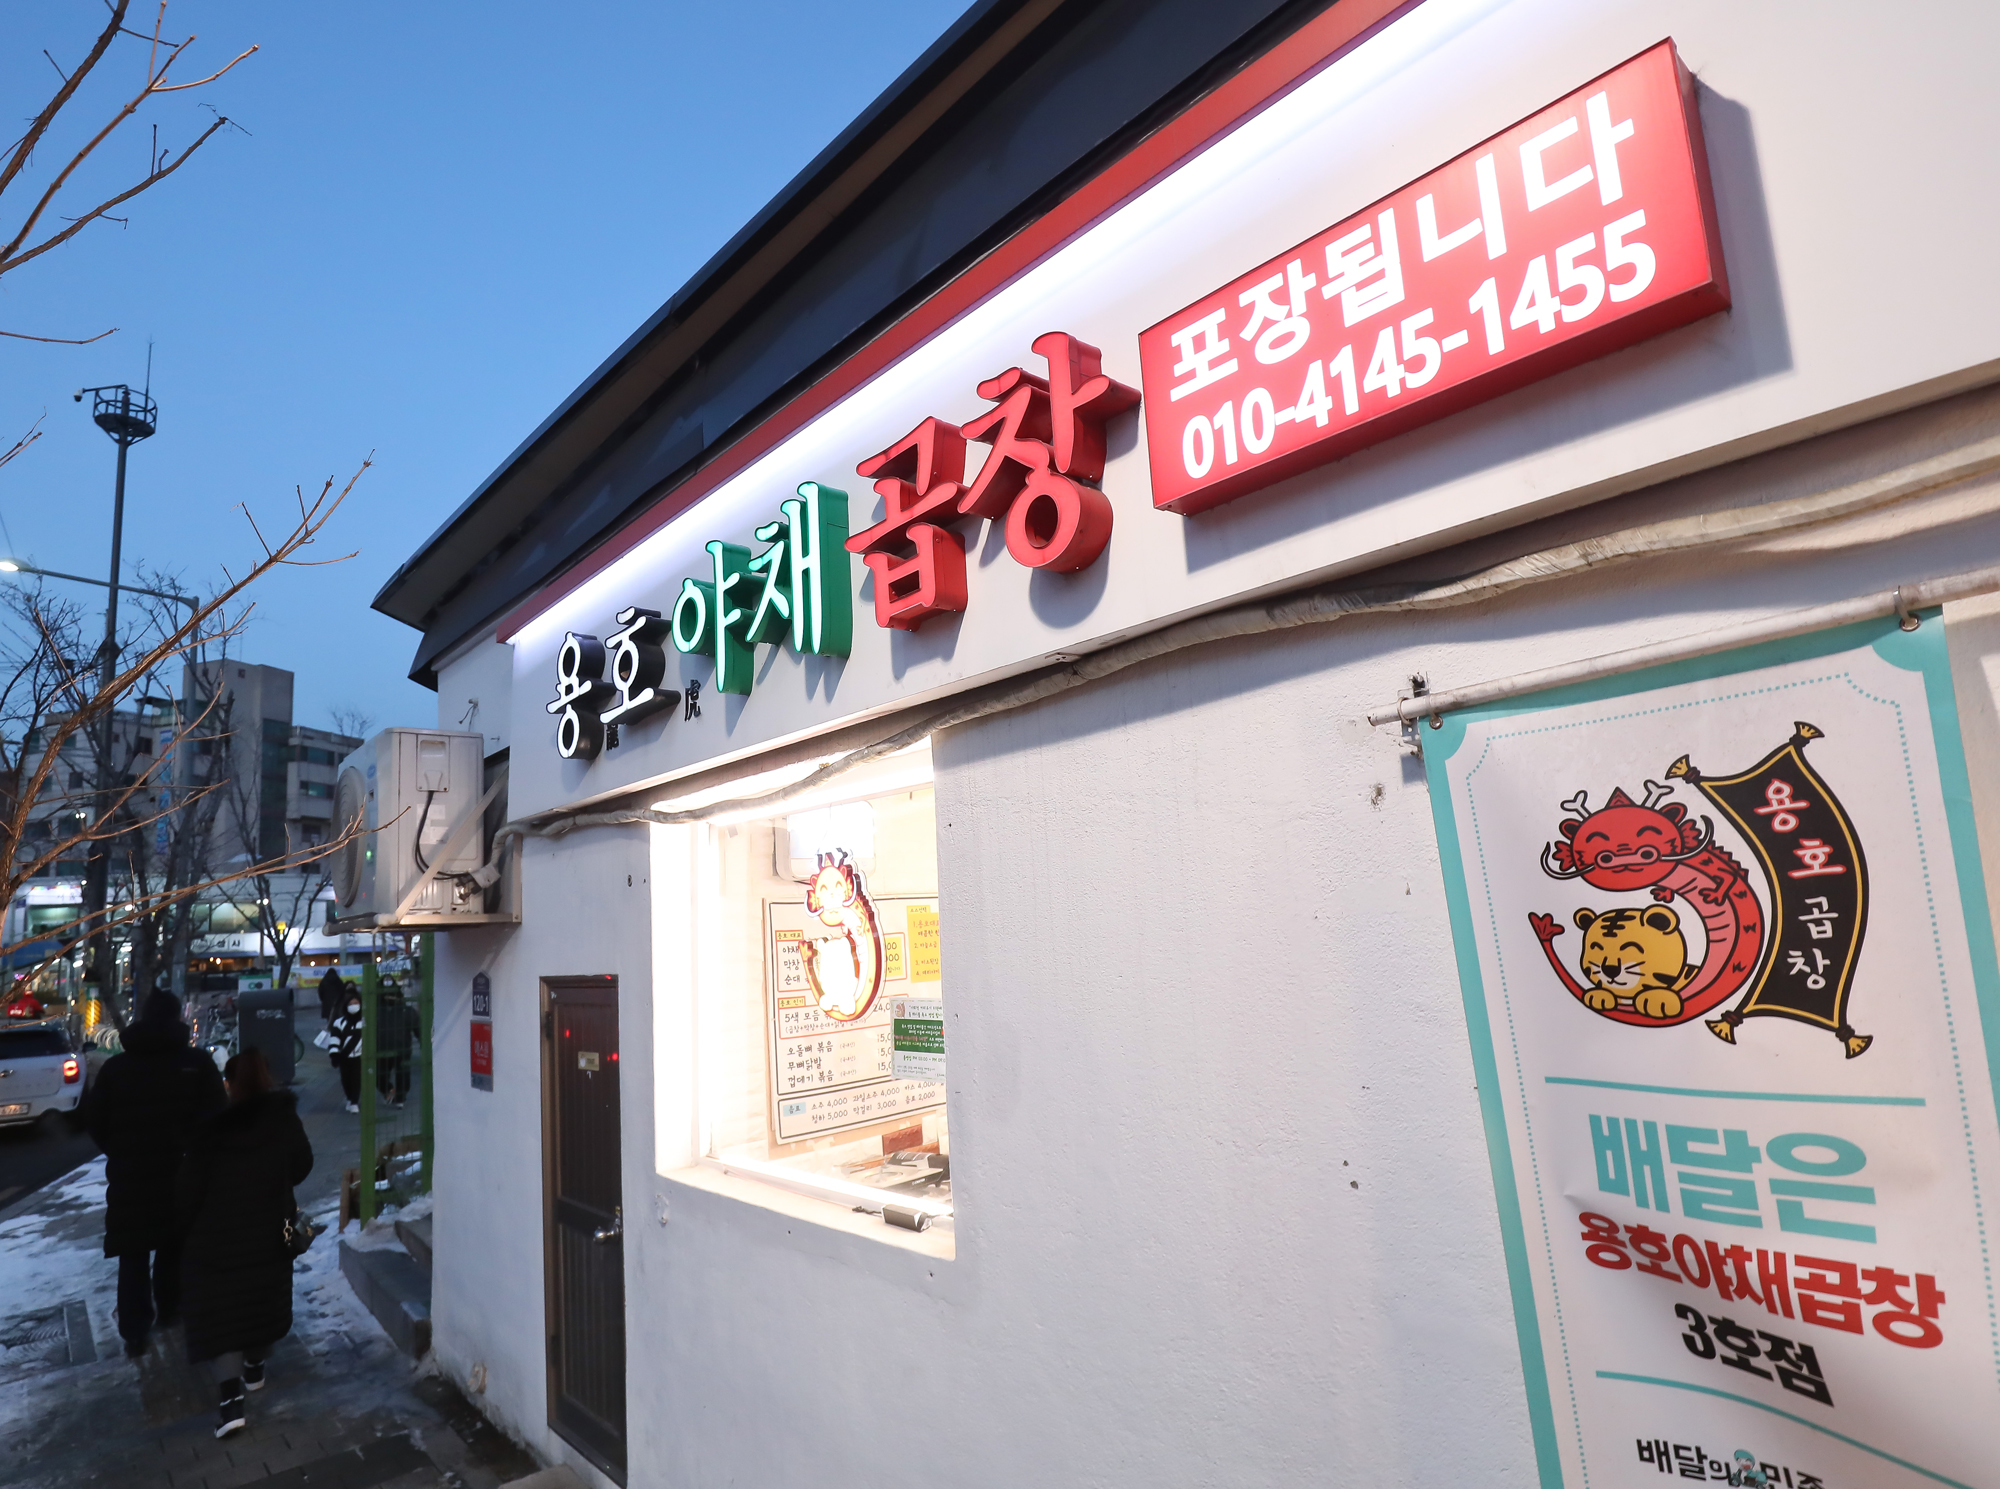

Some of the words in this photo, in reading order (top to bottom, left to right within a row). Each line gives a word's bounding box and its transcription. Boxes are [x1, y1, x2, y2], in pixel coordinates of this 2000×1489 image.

[1170, 91, 1634, 402] 포장됩니다
[1182, 209, 1656, 479] 010-4145-1455
[783, 959, 800, 971] 막창
[784, 974, 800, 986] 순대
[474, 995, 489, 1012] 120-1
[785, 1012, 799, 1023] 5색
[803, 1010, 820, 1022] 모듬
[817, 1040, 833, 1053] 볶음
[787, 1057, 822, 1071] 무뼈닭발
[788, 1074, 813, 1088] 껍데기
[818, 1070, 834, 1082] 볶음
[788, 1104, 801, 1114] 음료
[811, 1101, 824, 1111] 소주
[827, 1097, 848, 1108] 4,000
[852, 1091, 878, 1103] 과일소주
[880, 1086, 900, 1097] 4,000
[811, 1114, 825, 1124] 청하
[827, 1110, 848, 1121] 5,000
[853, 1104, 873, 1115] 막걸리
[877, 1099, 897, 1110] 3,000
[905, 1095, 916, 1104] 음료
[918, 1090, 936, 1101] 2,000
[1589, 1114, 1877, 1244] 배달은
[1578, 1211, 1946, 1348] 용호야채곱창
[1674, 1303, 1834, 1407] 3호점
[1636, 1439, 1732, 1487] 배달의
